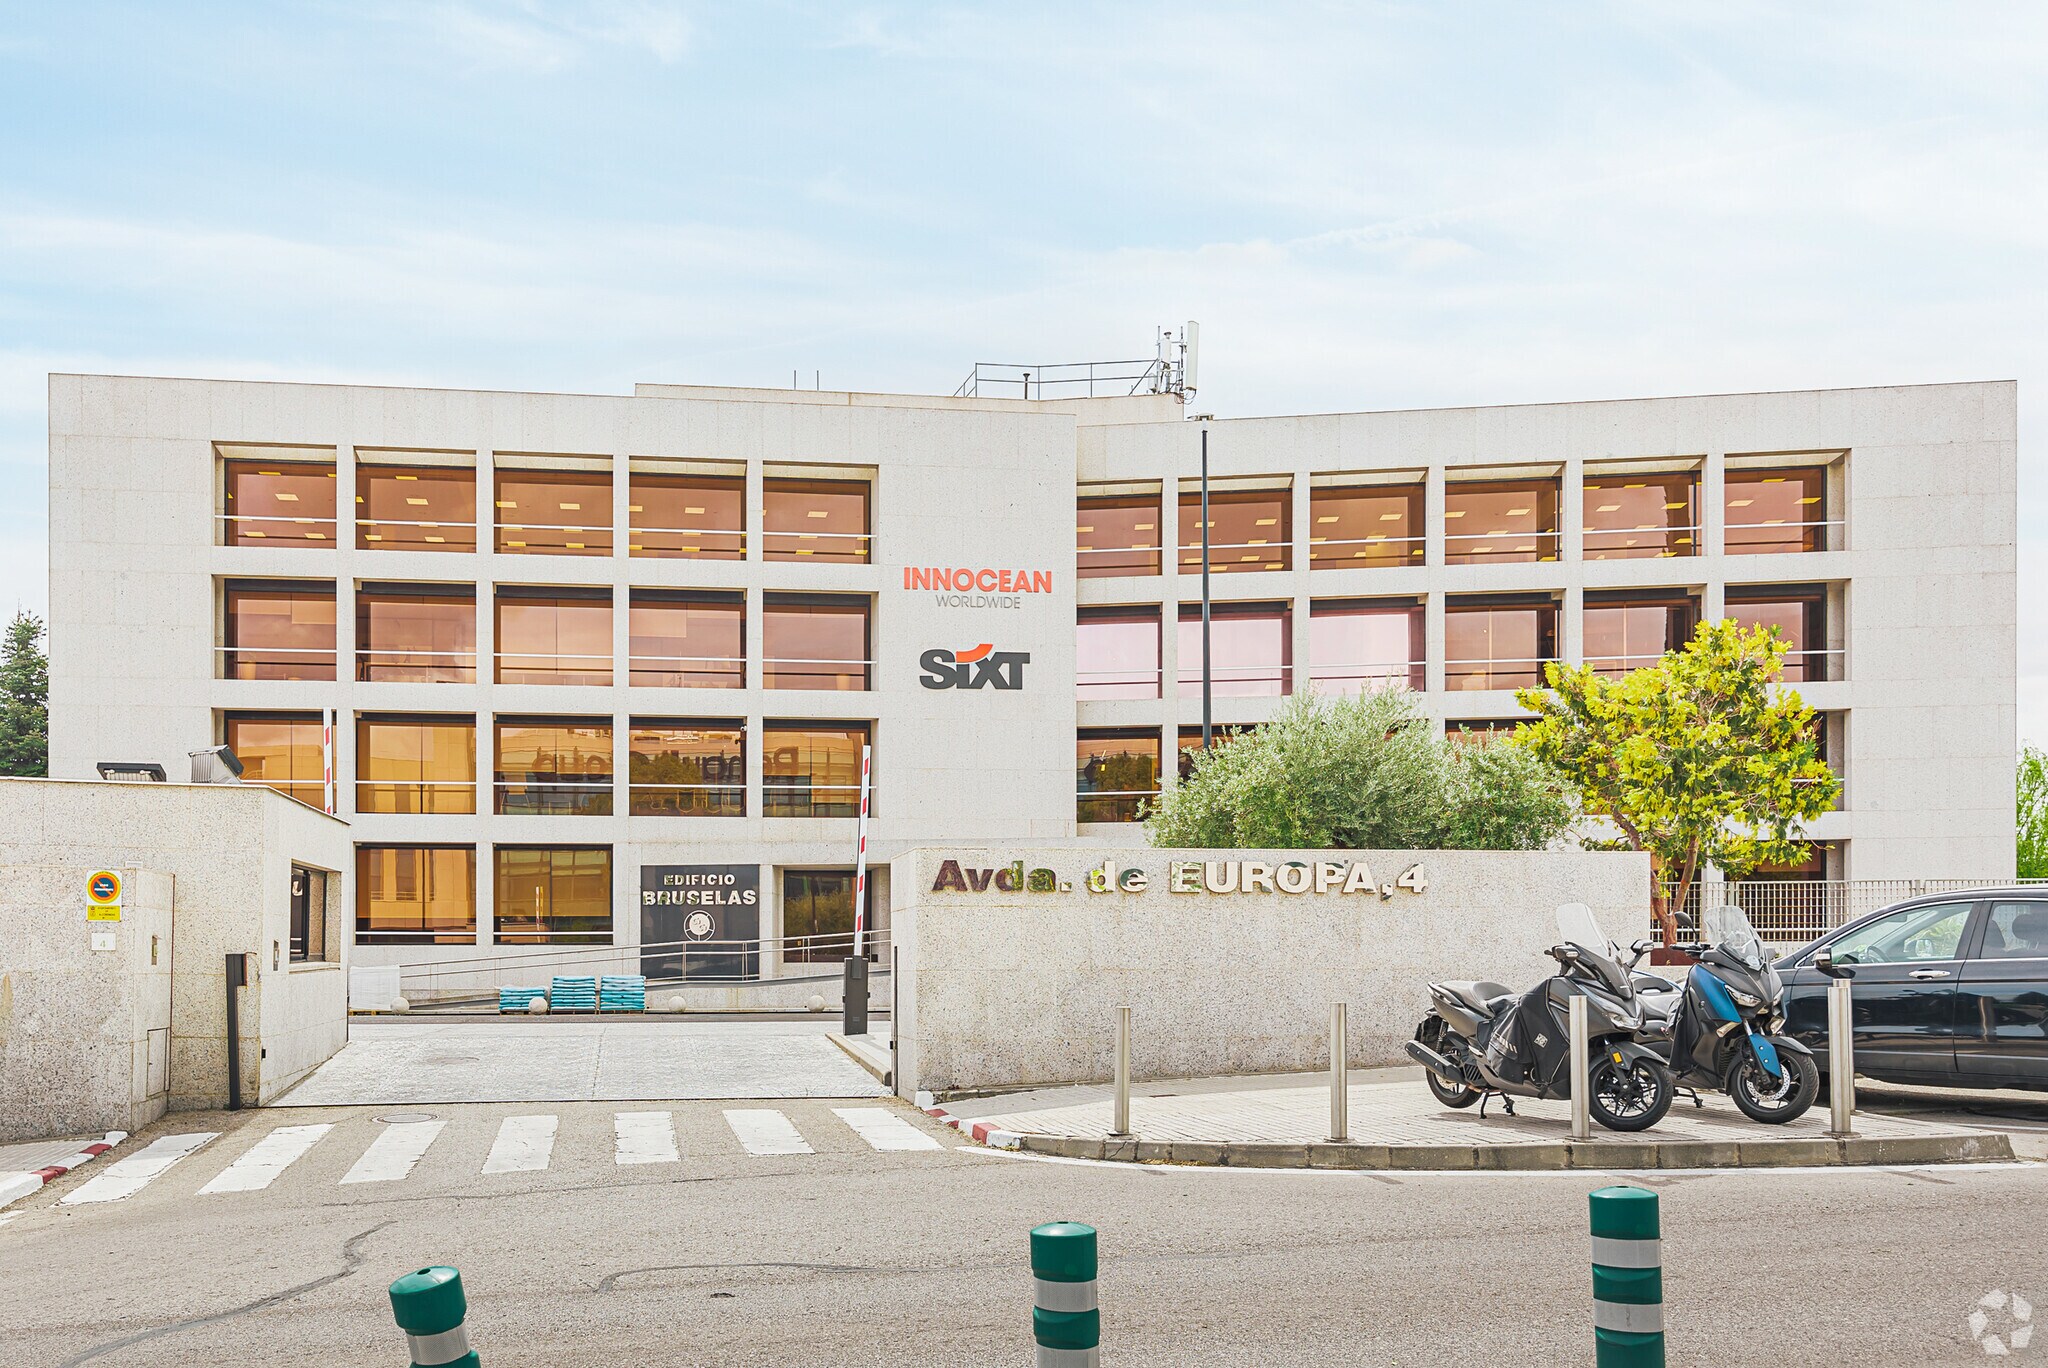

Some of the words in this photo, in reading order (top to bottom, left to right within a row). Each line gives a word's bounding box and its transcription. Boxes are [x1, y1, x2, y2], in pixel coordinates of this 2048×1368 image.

[904, 567, 1052, 593] INNOCEAN
[935, 594, 1021, 609] WORLDWIDE
[919, 643, 1031, 690] SIXT
[663, 873, 736, 886] EDIFICIO
[931, 859, 1073, 893] Avda.
[1086, 860, 1149, 893] de
[642, 889, 757, 906] BRUSELAS
